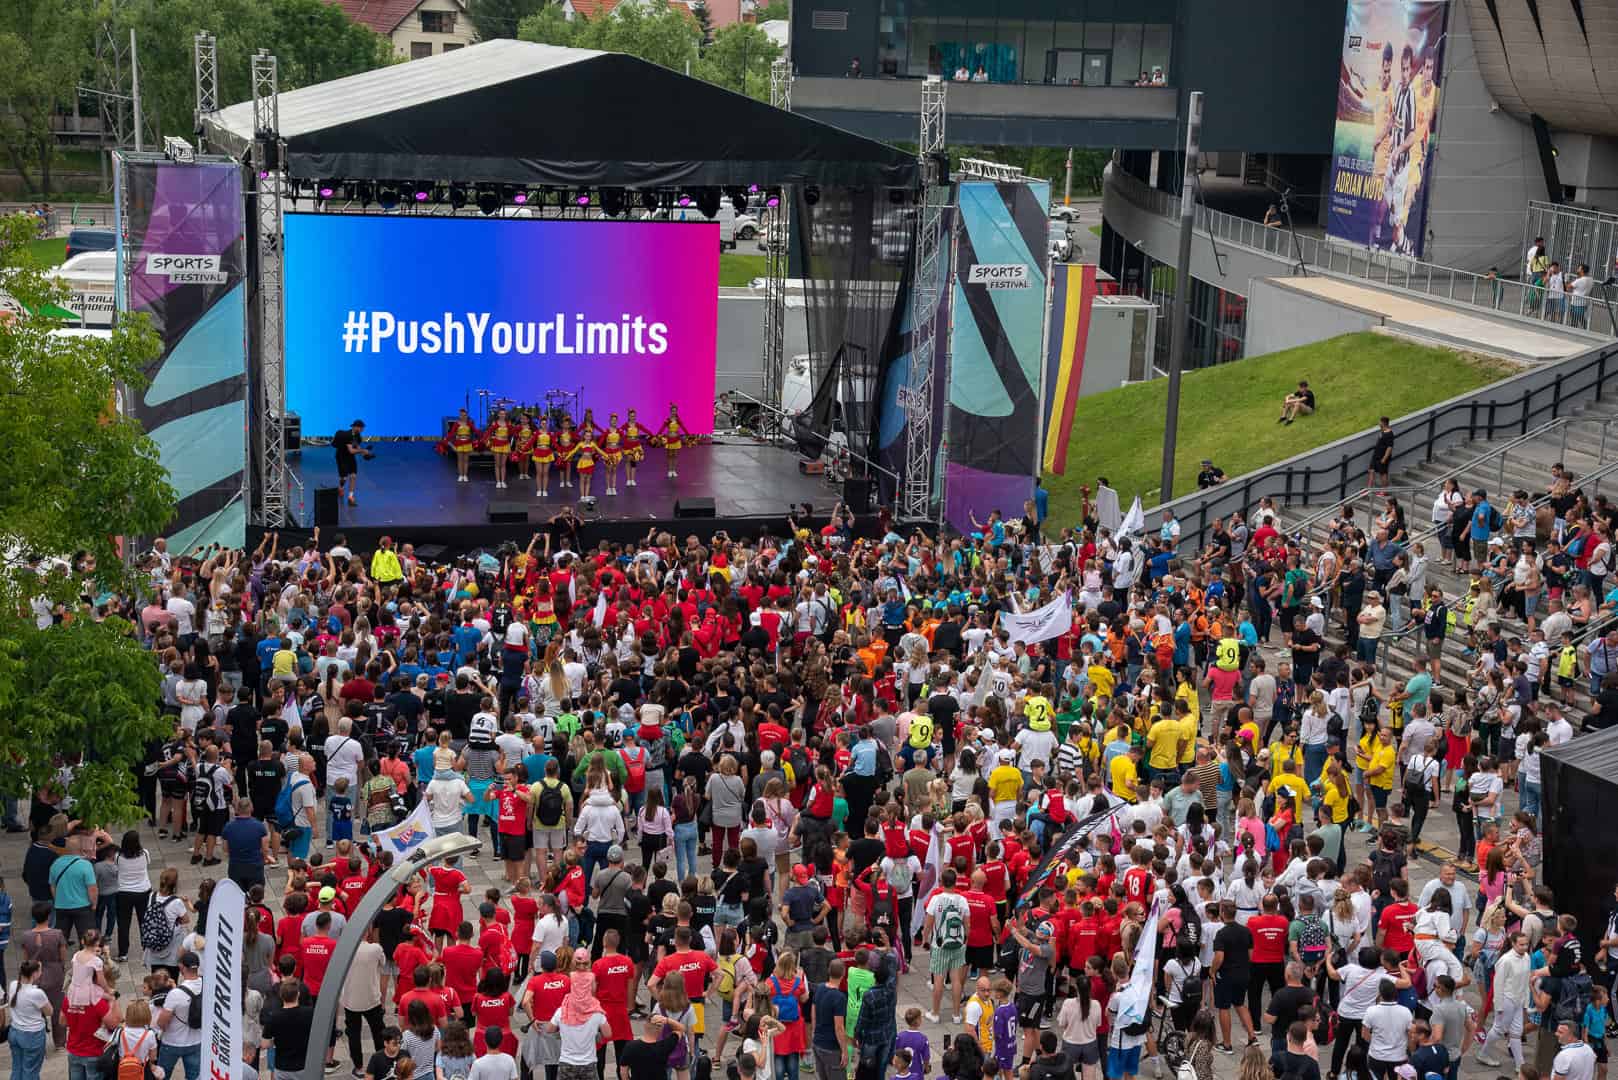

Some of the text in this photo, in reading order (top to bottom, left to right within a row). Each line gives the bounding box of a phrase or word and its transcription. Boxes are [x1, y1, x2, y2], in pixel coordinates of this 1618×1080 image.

[1335, 170, 1361, 197] ADRIAN
[153, 257, 214, 269] SPORTS
[174, 273, 224, 281] FESTIVAL
[975, 266, 1023, 278] SPORTS
[990, 280, 1030, 289] FESTIVAL
[87, 295, 113, 303] RALL
[70, 303, 114, 312] ACADEM
[342, 310, 669, 355] #PushYourLimits
[497, 614, 505, 627] 1
[1227, 647, 1236, 665] 9
[1036, 704, 1045, 722] 2
[376, 712, 382, 728] 1
[920, 724, 930, 742] 9
[1128, 874, 1140, 896] 18
[214, 912, 233, 1028] PRIVATI
[607, 964, 628, 975] ACSK
[680, 961, 701, 972] ACSK
[543, 979, 565, 990] ACSK
[480, 998, 505, 1008] ACSK
[219, 1029, 231, 1066] BANI
